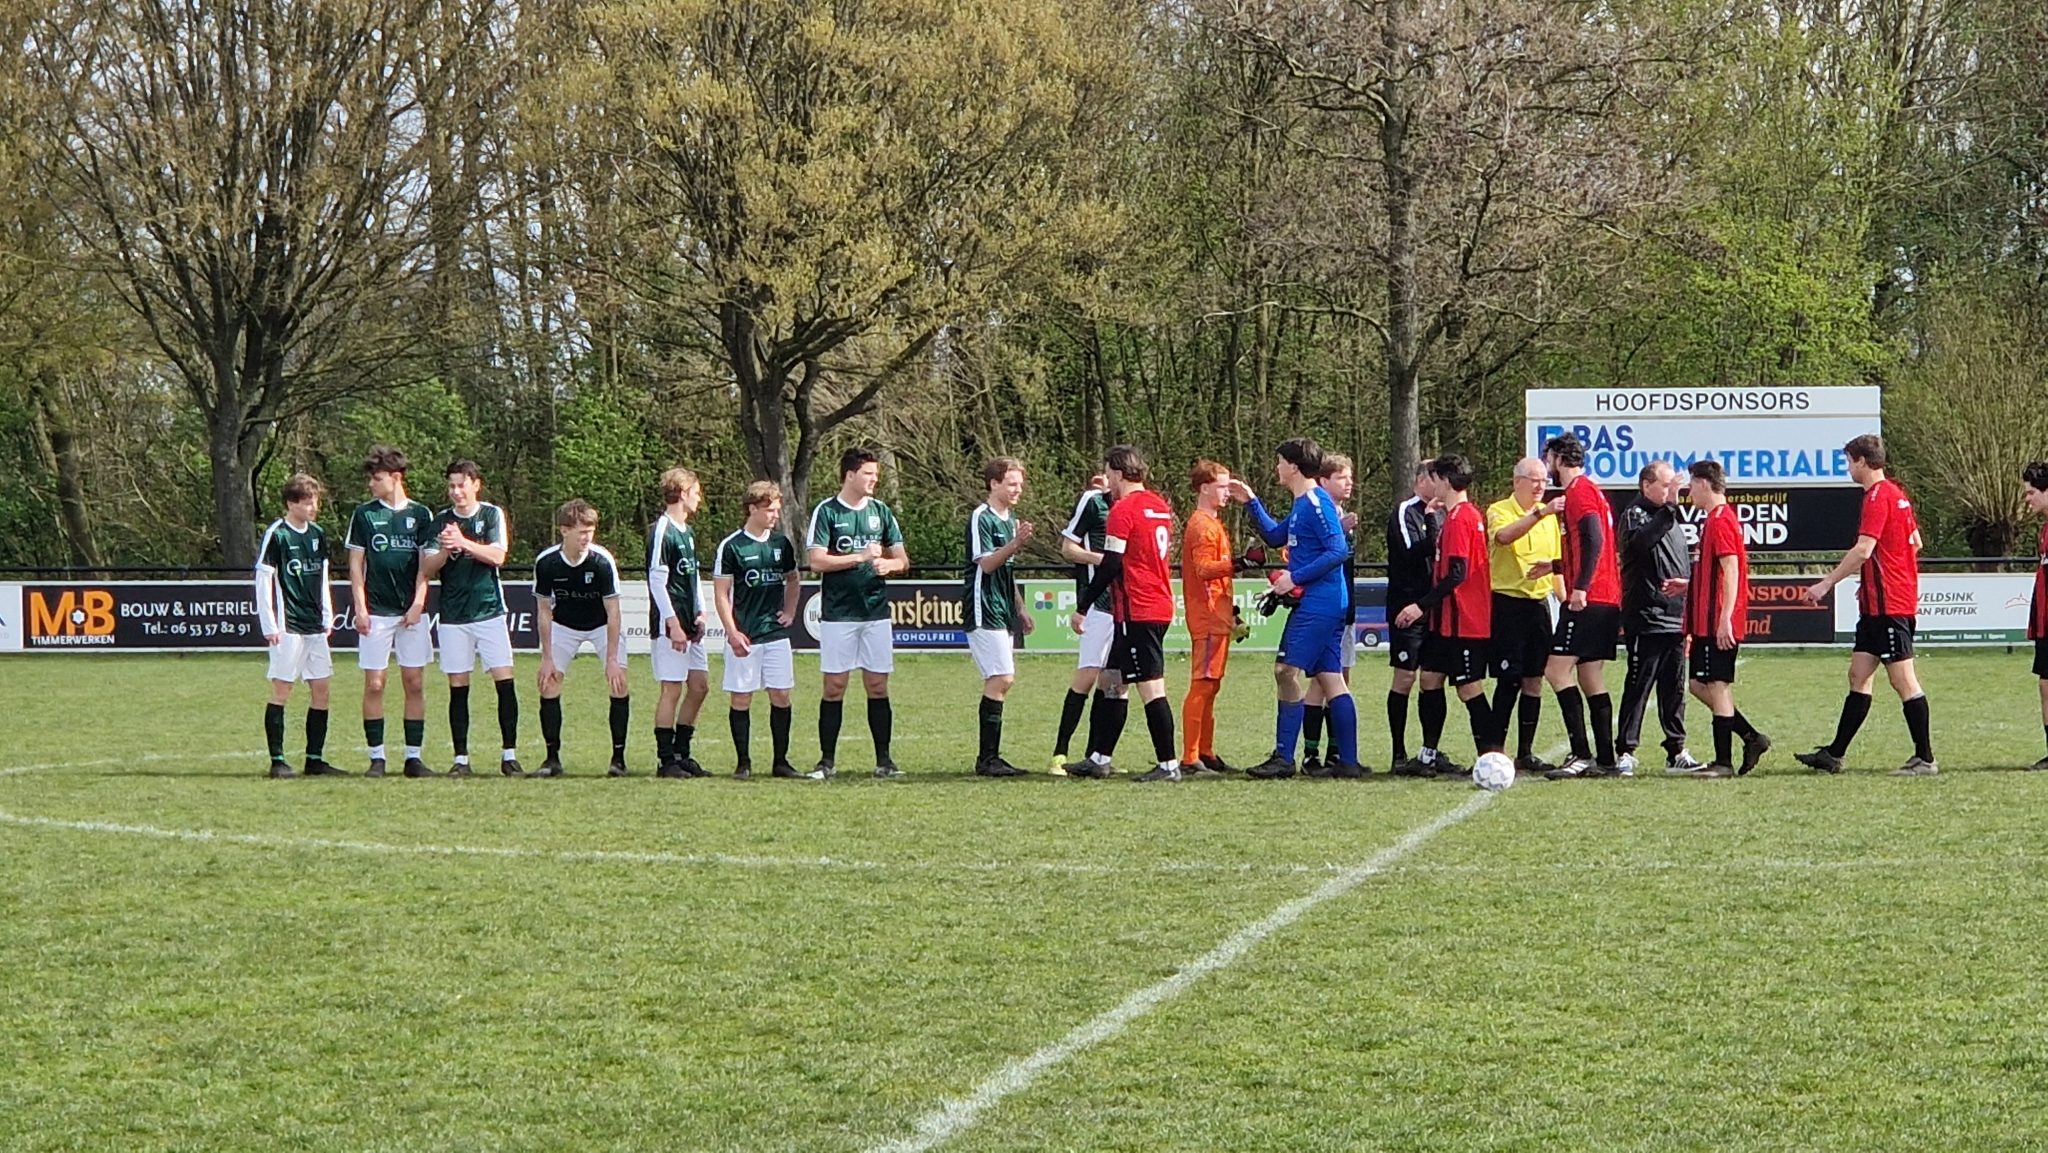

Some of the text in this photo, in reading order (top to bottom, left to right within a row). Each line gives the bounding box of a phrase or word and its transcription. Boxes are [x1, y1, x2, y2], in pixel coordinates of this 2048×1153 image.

[1596, 392, 1810, 411] HOOFDSPONSORS
[1573, 424, 1634, 451] BAS
[1679, 503, 1788, 522] VA DEN
[1155, 525, 1169, 560] 9
[121, 601, 259, 617] BOUW & INTERIEU
[888, 589, 964, 629] arsteine
[142, 621, 251, 636] Tel.: 06 53 57 82 91
[31, 634, 115, 645] TIMMERWERKEN
